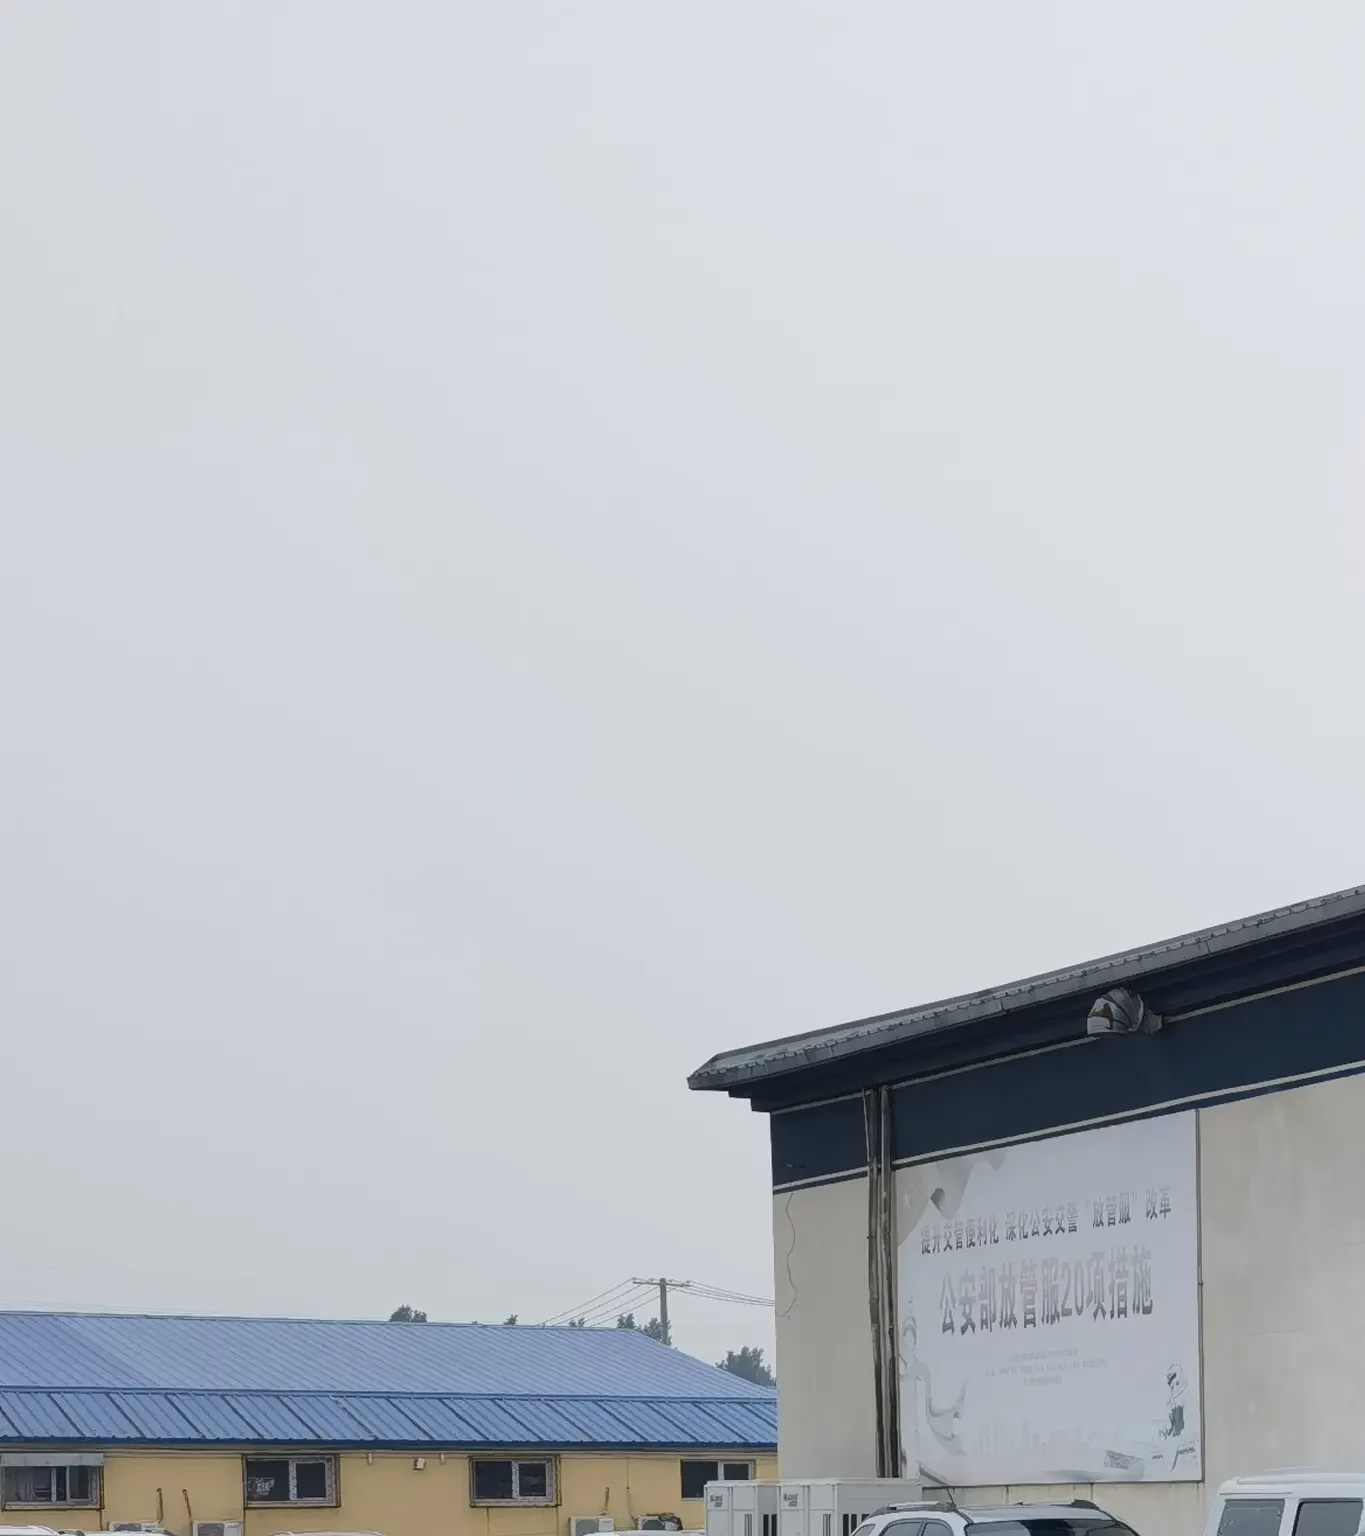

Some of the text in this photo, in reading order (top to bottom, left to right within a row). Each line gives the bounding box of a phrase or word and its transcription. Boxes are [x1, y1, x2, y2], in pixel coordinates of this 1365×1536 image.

[939, 1245, 1153, 1335] 公安部放管服20项措施
